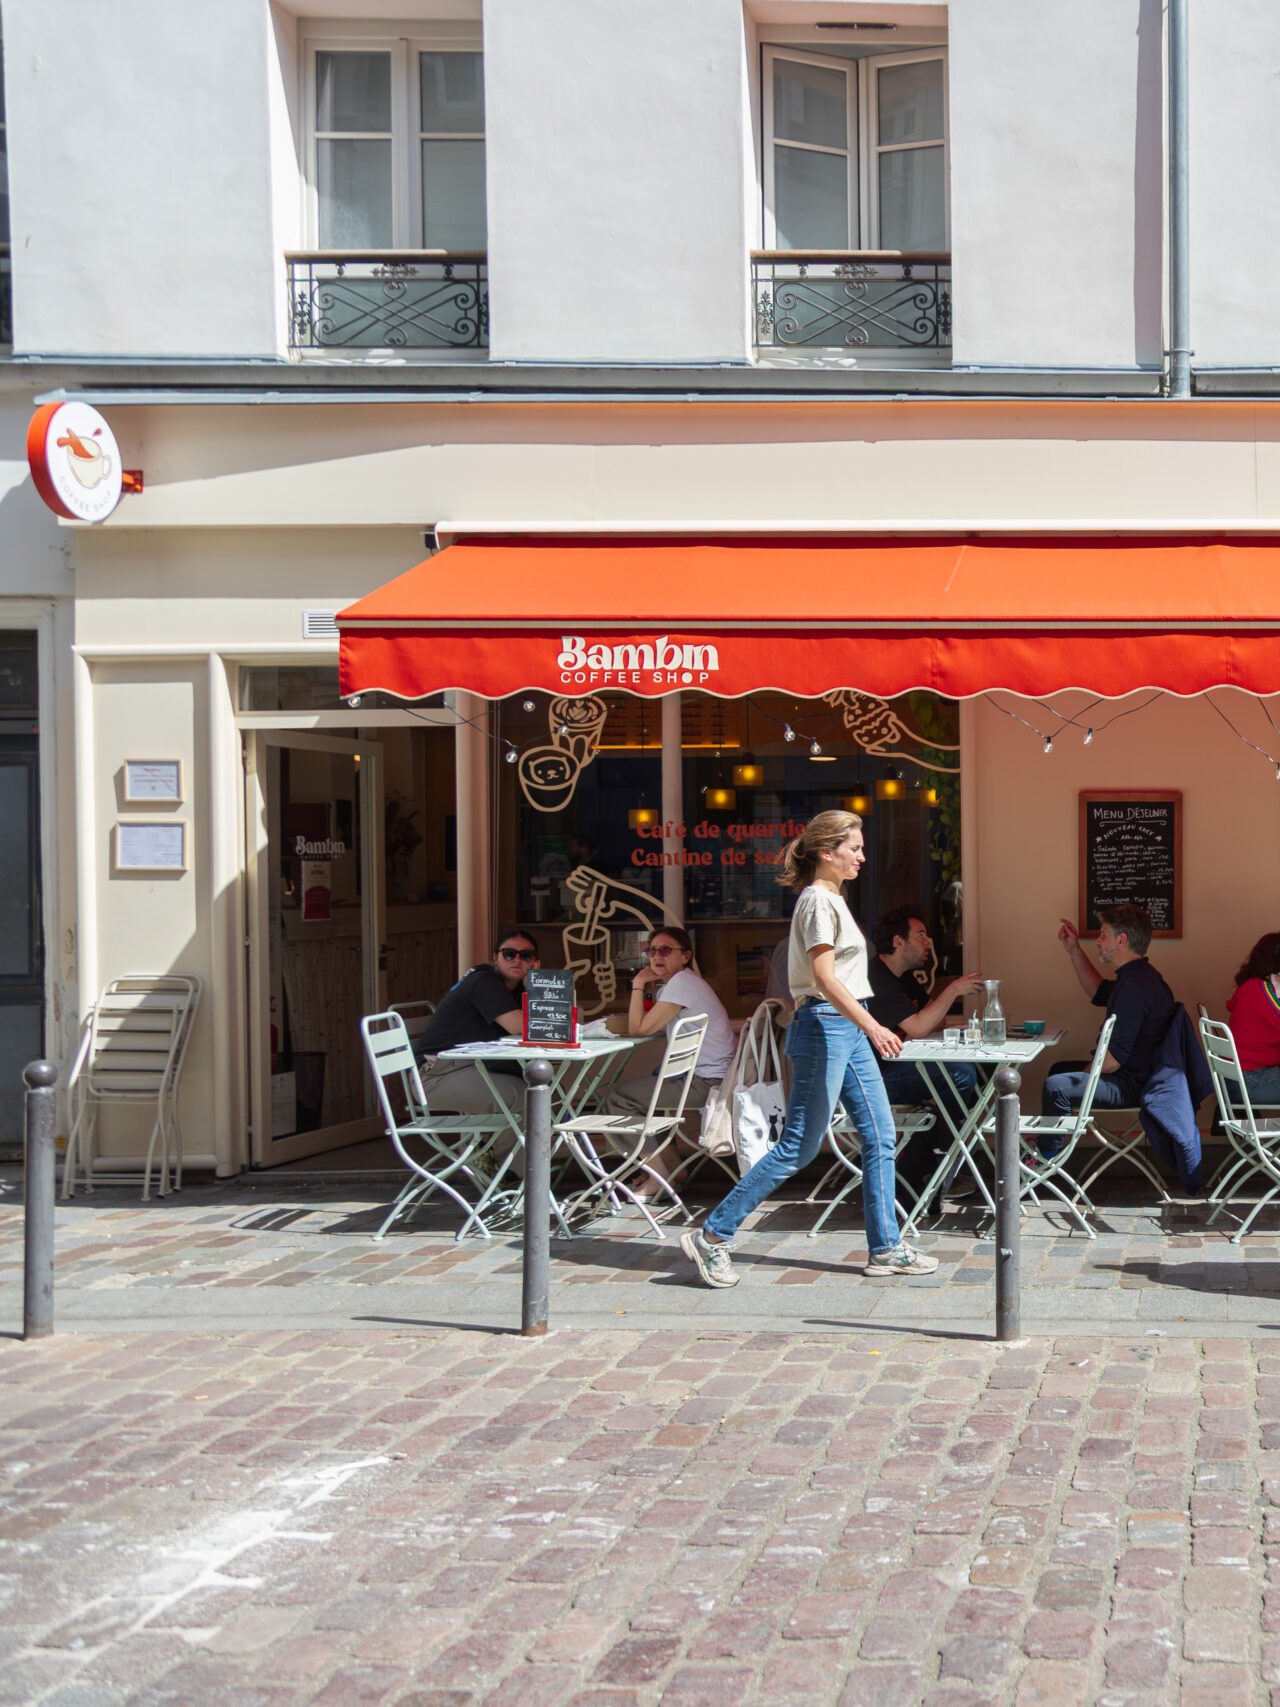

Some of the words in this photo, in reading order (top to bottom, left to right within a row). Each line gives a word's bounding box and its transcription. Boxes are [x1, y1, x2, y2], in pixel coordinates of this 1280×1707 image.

[556, 635, 720, 671] Bambin
[560, 671, 641, 684] COFFEE
[652, 671, 710, 684] SHOP
[1093, 808, 1124, 820] MENU
[1125, 806, 1169, 821] DÉJEUNER
[635, 819, 687, 839] Café
[693, 819, 721, 839] de
[726, 818, 807, 842] quartie
[630, 847, 713, 867] Cantine
[720, 847, 747, 866] de
[530, 972, 566, 985] Formules
